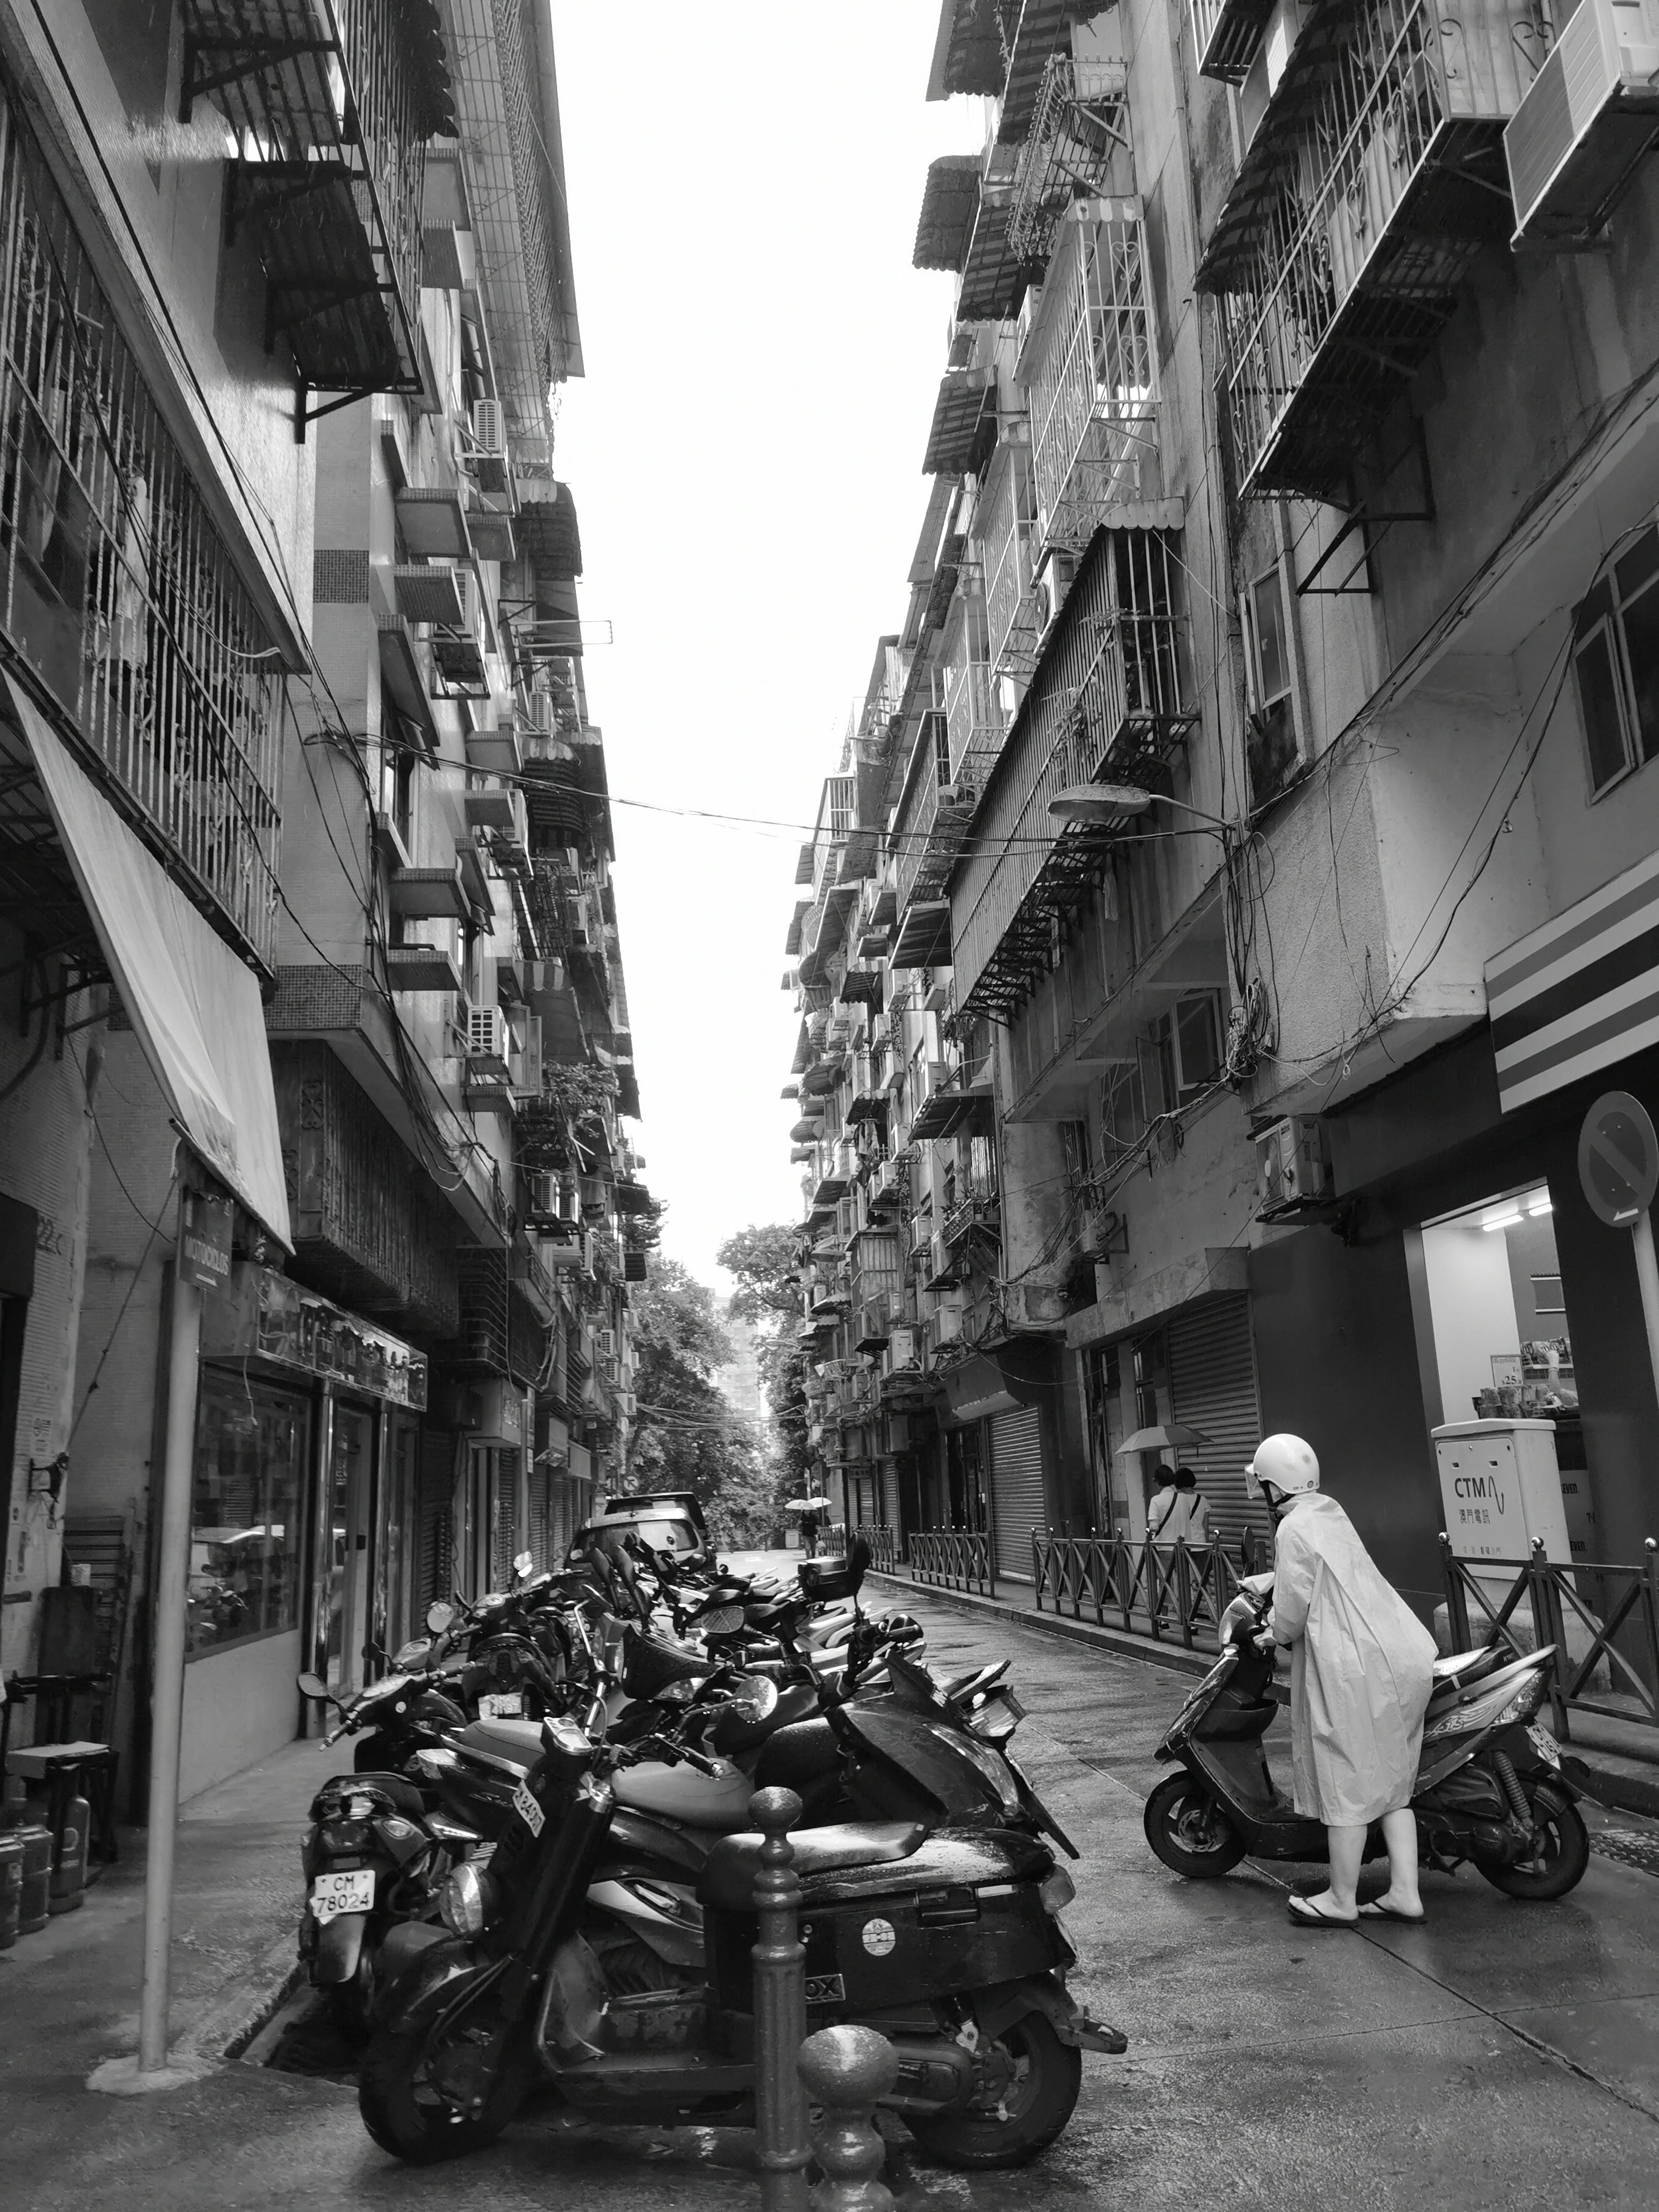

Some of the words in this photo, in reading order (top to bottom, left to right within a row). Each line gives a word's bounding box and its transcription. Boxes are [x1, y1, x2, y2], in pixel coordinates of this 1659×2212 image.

[1455, 1477, 1486, 1498] CTM
[1532, 1726, 1547, 1741] CM
[333, 1875, 355, 1891] CM
[317, 1892, 369, 1914] 78024
